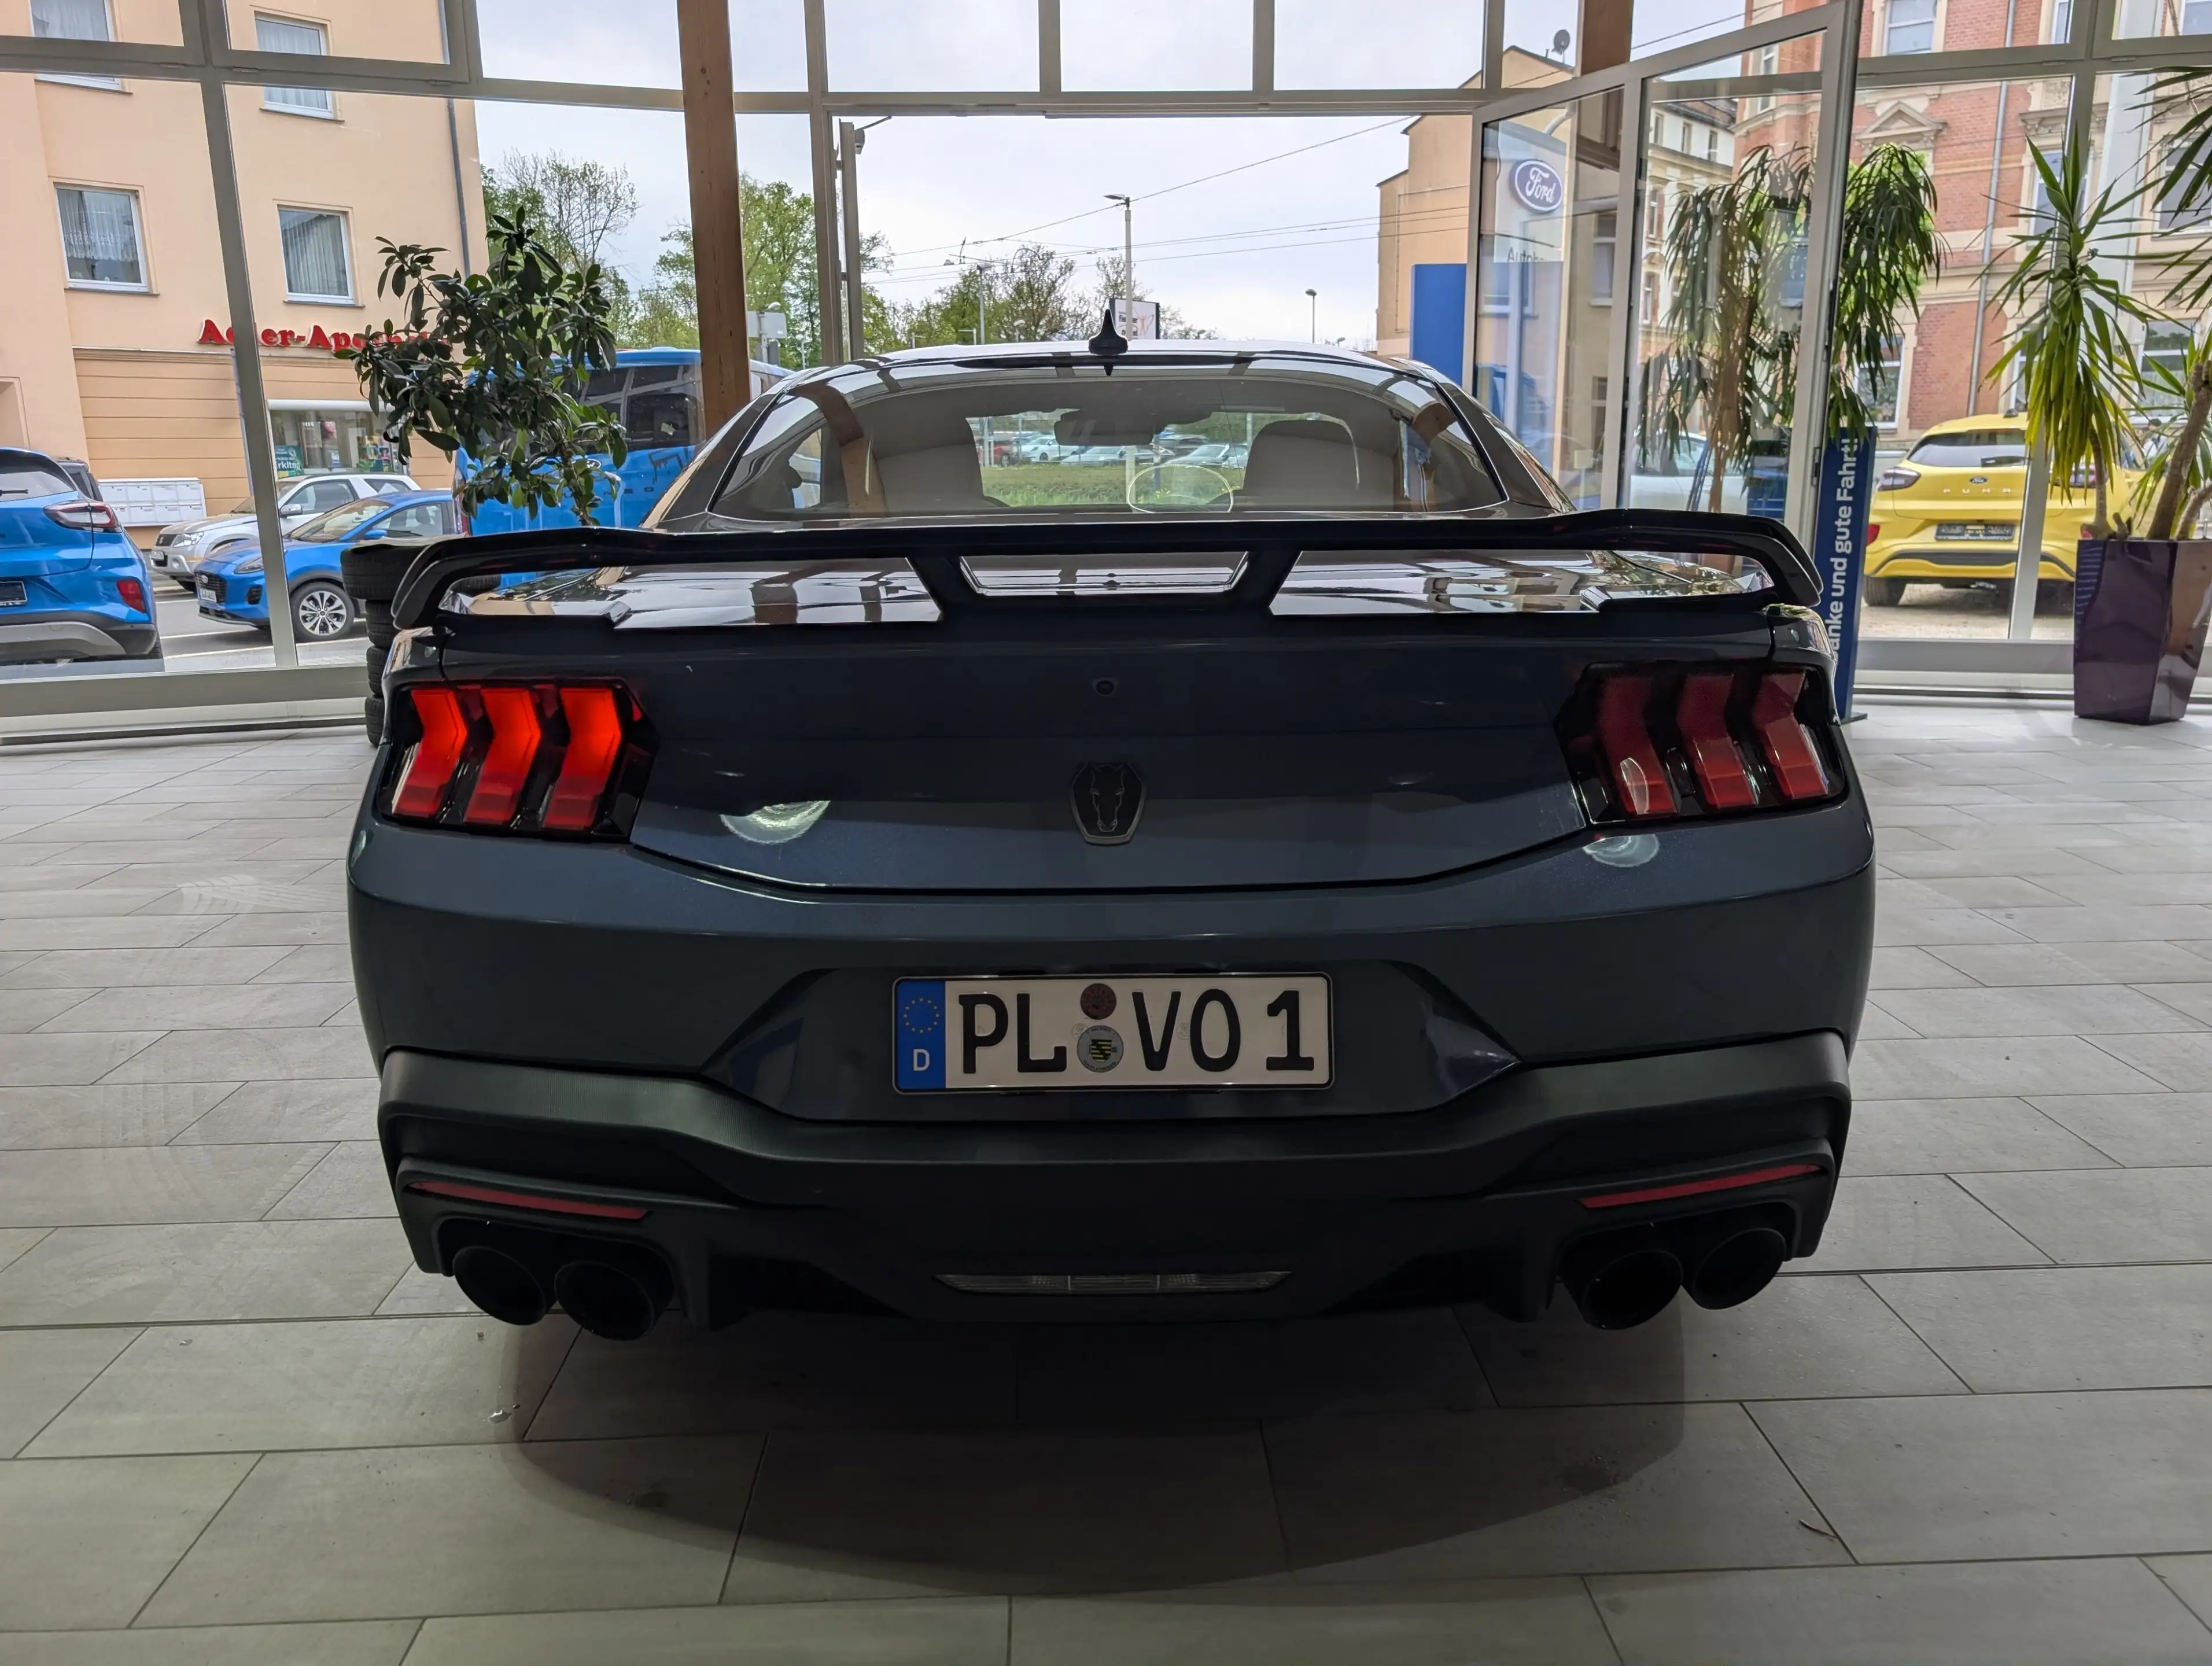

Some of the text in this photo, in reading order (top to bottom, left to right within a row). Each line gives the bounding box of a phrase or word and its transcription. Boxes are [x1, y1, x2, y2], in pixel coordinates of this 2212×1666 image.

[1525, 167, 1557, 203] Ford
[1825, 438, 1858, 663] anke und gute Fahrt!
[913, 1049, 930, 1071] D
[958, 993, 1067, 1074] PL
[1266, 990, 1315, 1072] 1
